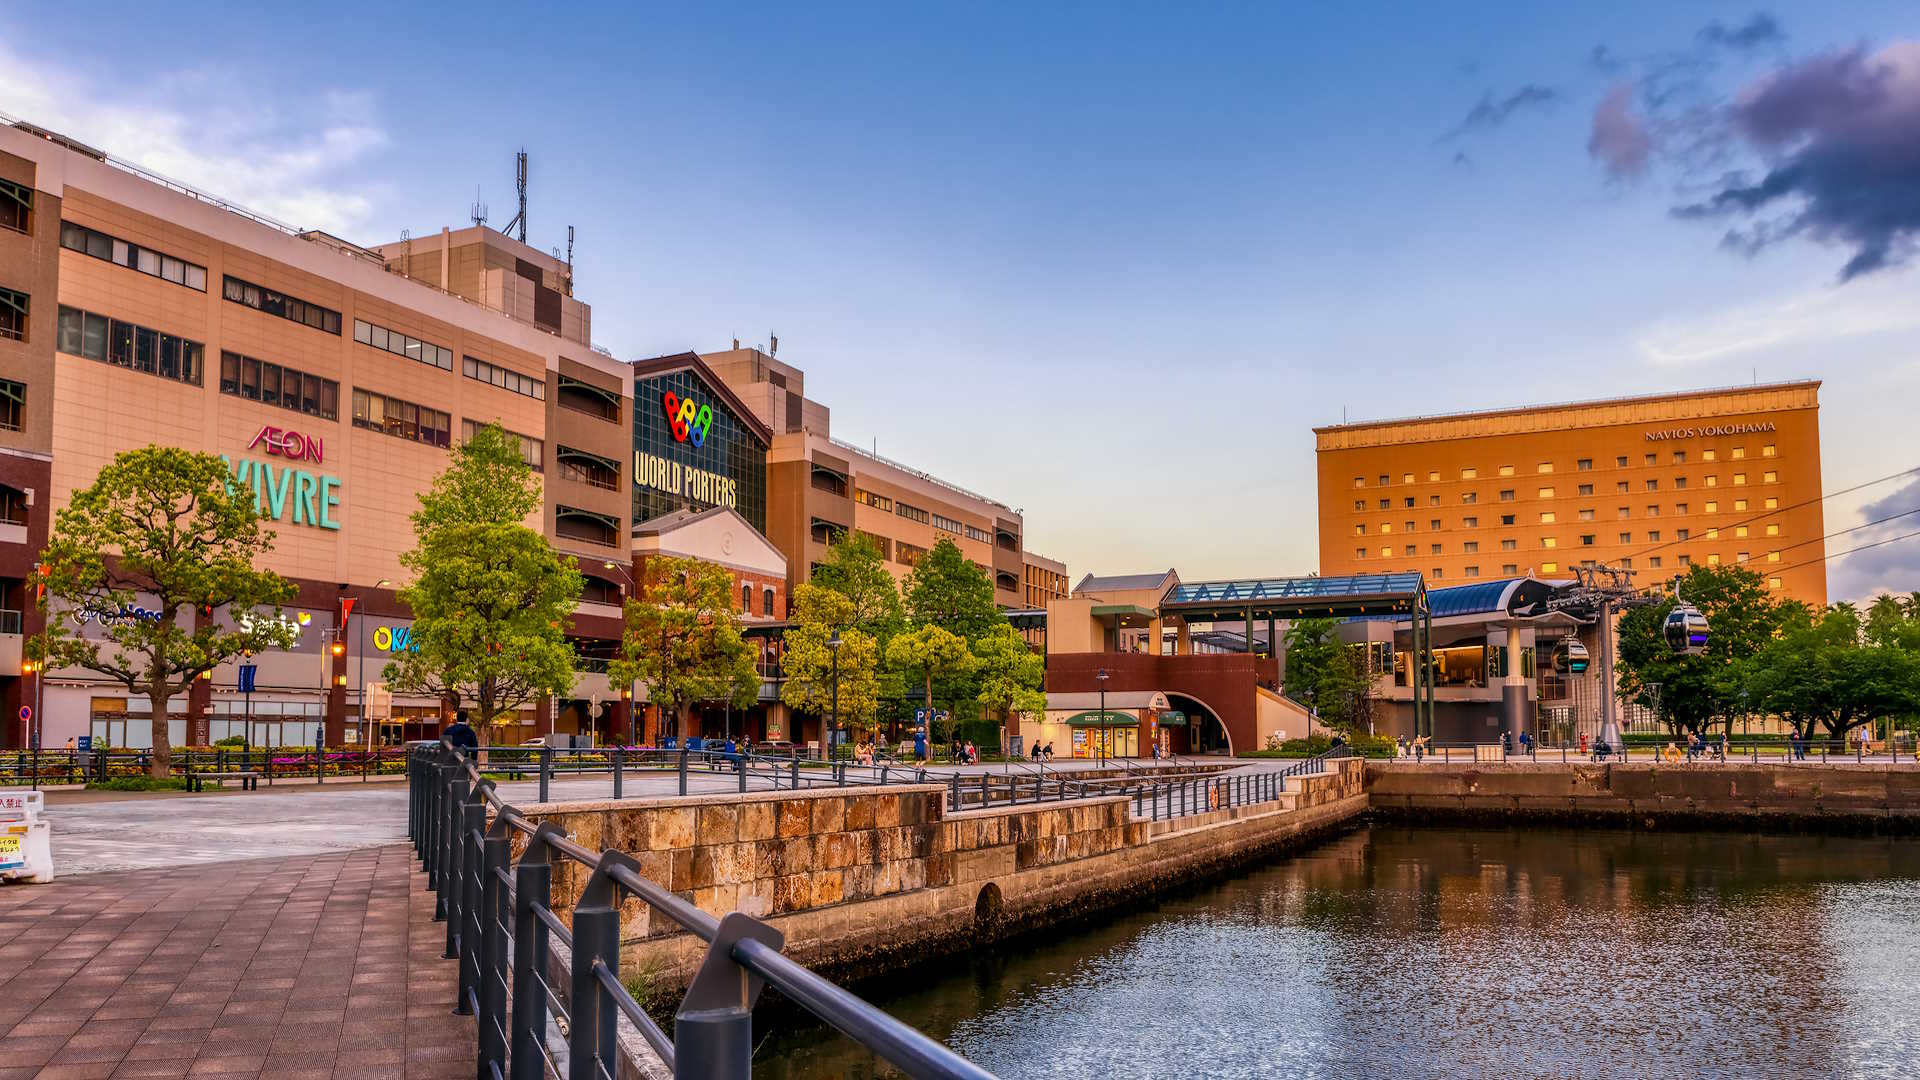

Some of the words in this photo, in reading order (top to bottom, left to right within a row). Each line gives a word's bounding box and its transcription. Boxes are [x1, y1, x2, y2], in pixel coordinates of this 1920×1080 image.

[1645, 427, 1694, 442] NAVIOS
[1697, 421, 1776, 437] YOKOHAMA
[220, 453, 342, 530] VIVRE
[635, 450, 681, 495] WORLD
[684, 465, 736, 509] PORTERS
[917, 711, 925, 722] P
